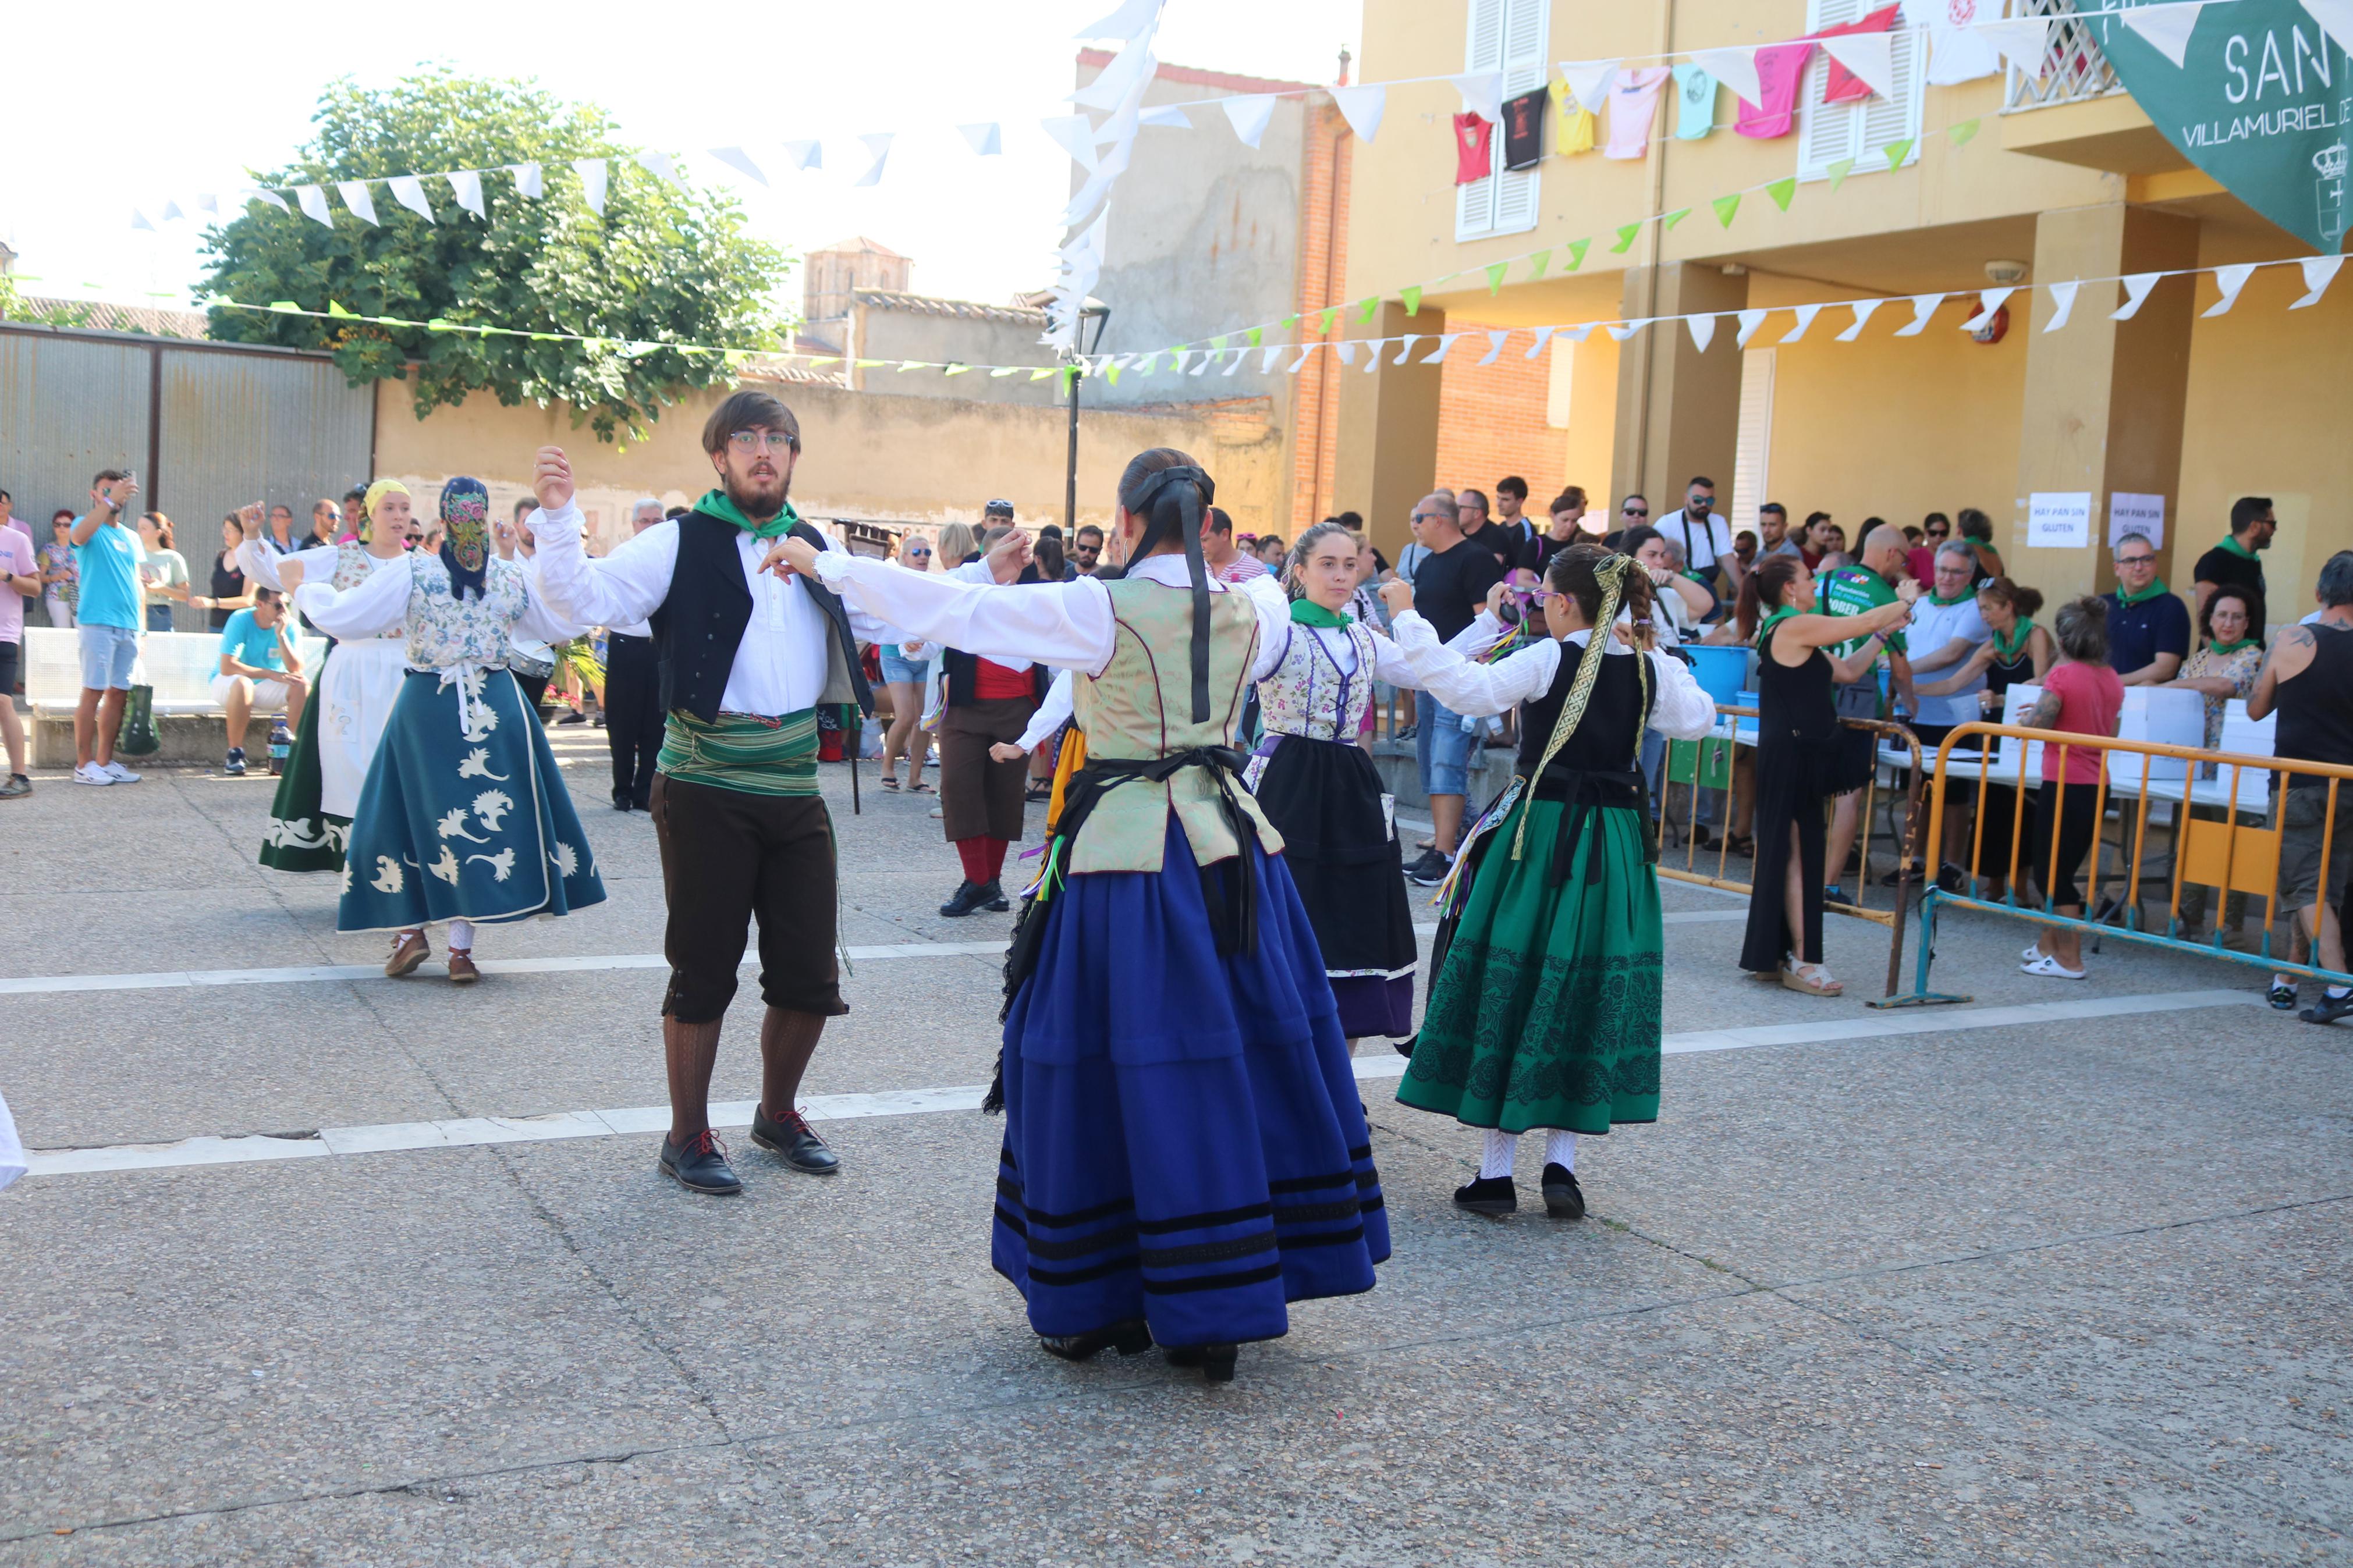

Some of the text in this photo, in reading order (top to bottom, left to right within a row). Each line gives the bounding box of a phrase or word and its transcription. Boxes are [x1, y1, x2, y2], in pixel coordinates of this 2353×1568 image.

[2182, 97, 2352, 147] VILLAMURIEL DE
[2034, 507, 2085, 516] HAY PAN SIN
[2114, 508, 2160, 518] HAY PAN SIN
[2042, 523, 2074, 532] GLUTEN
[1829, 598, 1859, 616] OBER
